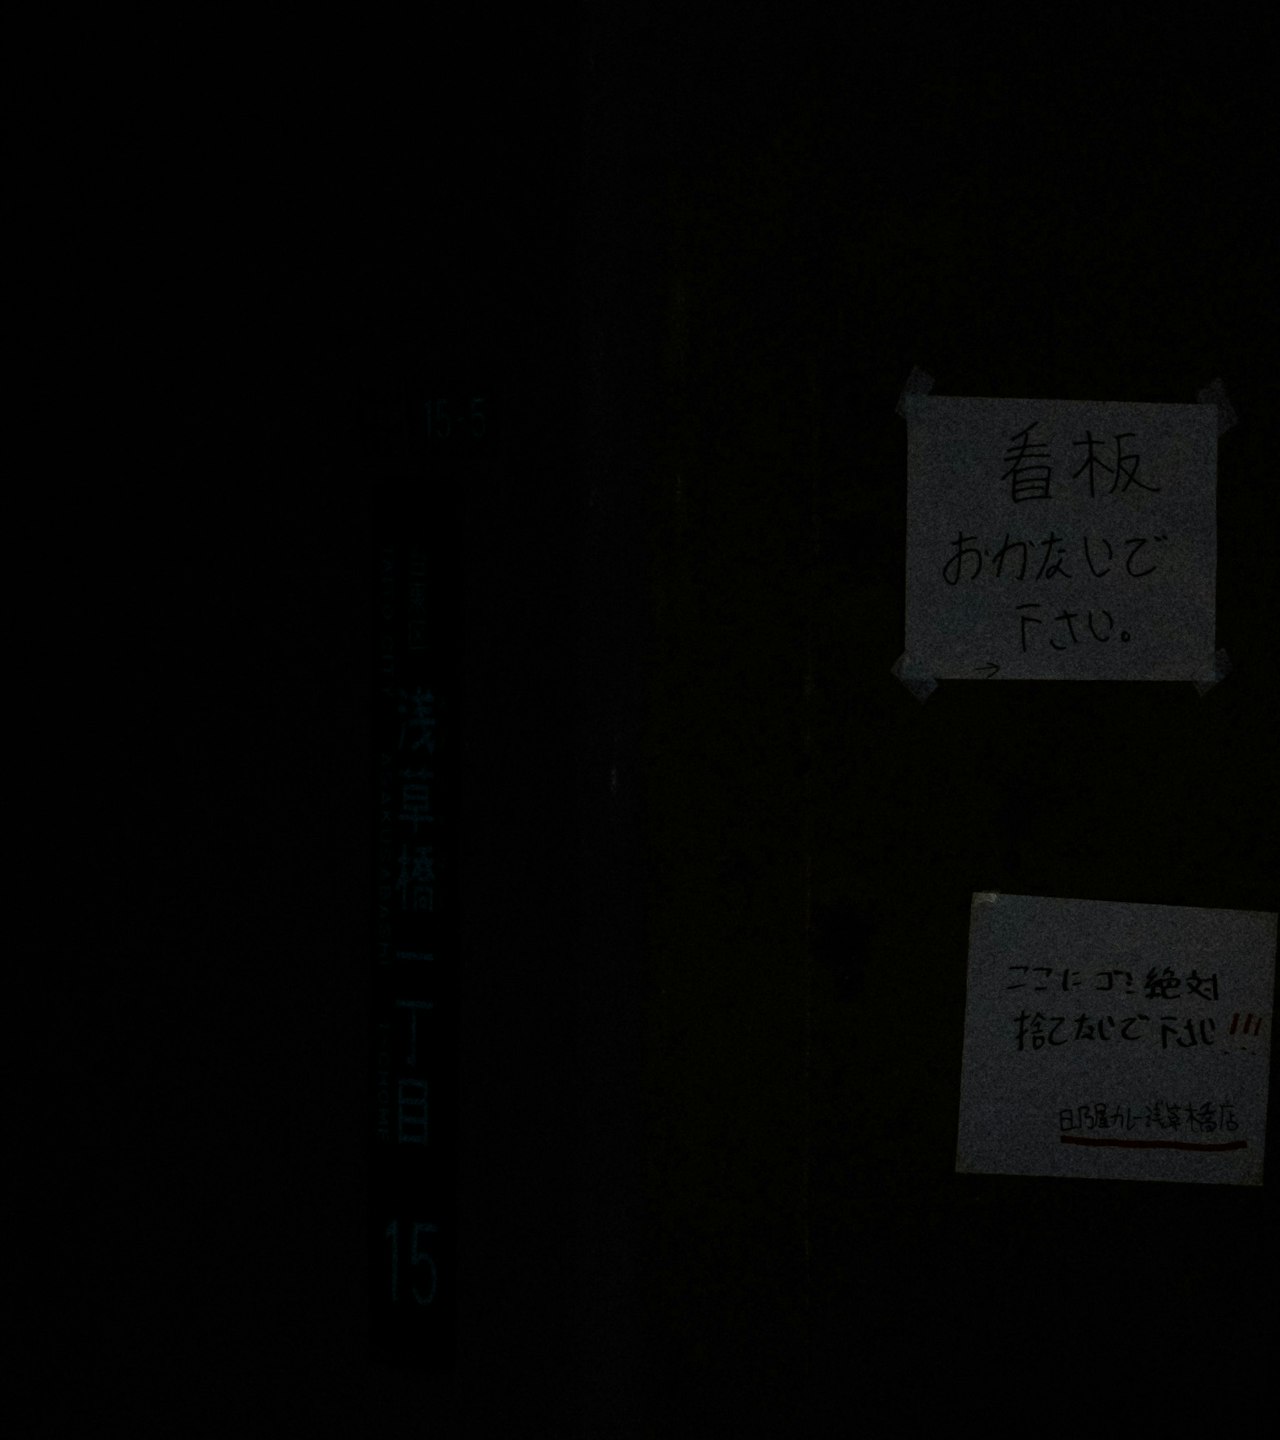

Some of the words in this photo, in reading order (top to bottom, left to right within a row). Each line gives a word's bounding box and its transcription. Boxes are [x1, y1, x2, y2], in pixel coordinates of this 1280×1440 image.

[1001, 421, 1161, 503] 看板
[395, 685, 438, 1147] 浅草橋一丁目
[383, 1219, 441, 1307] 15
